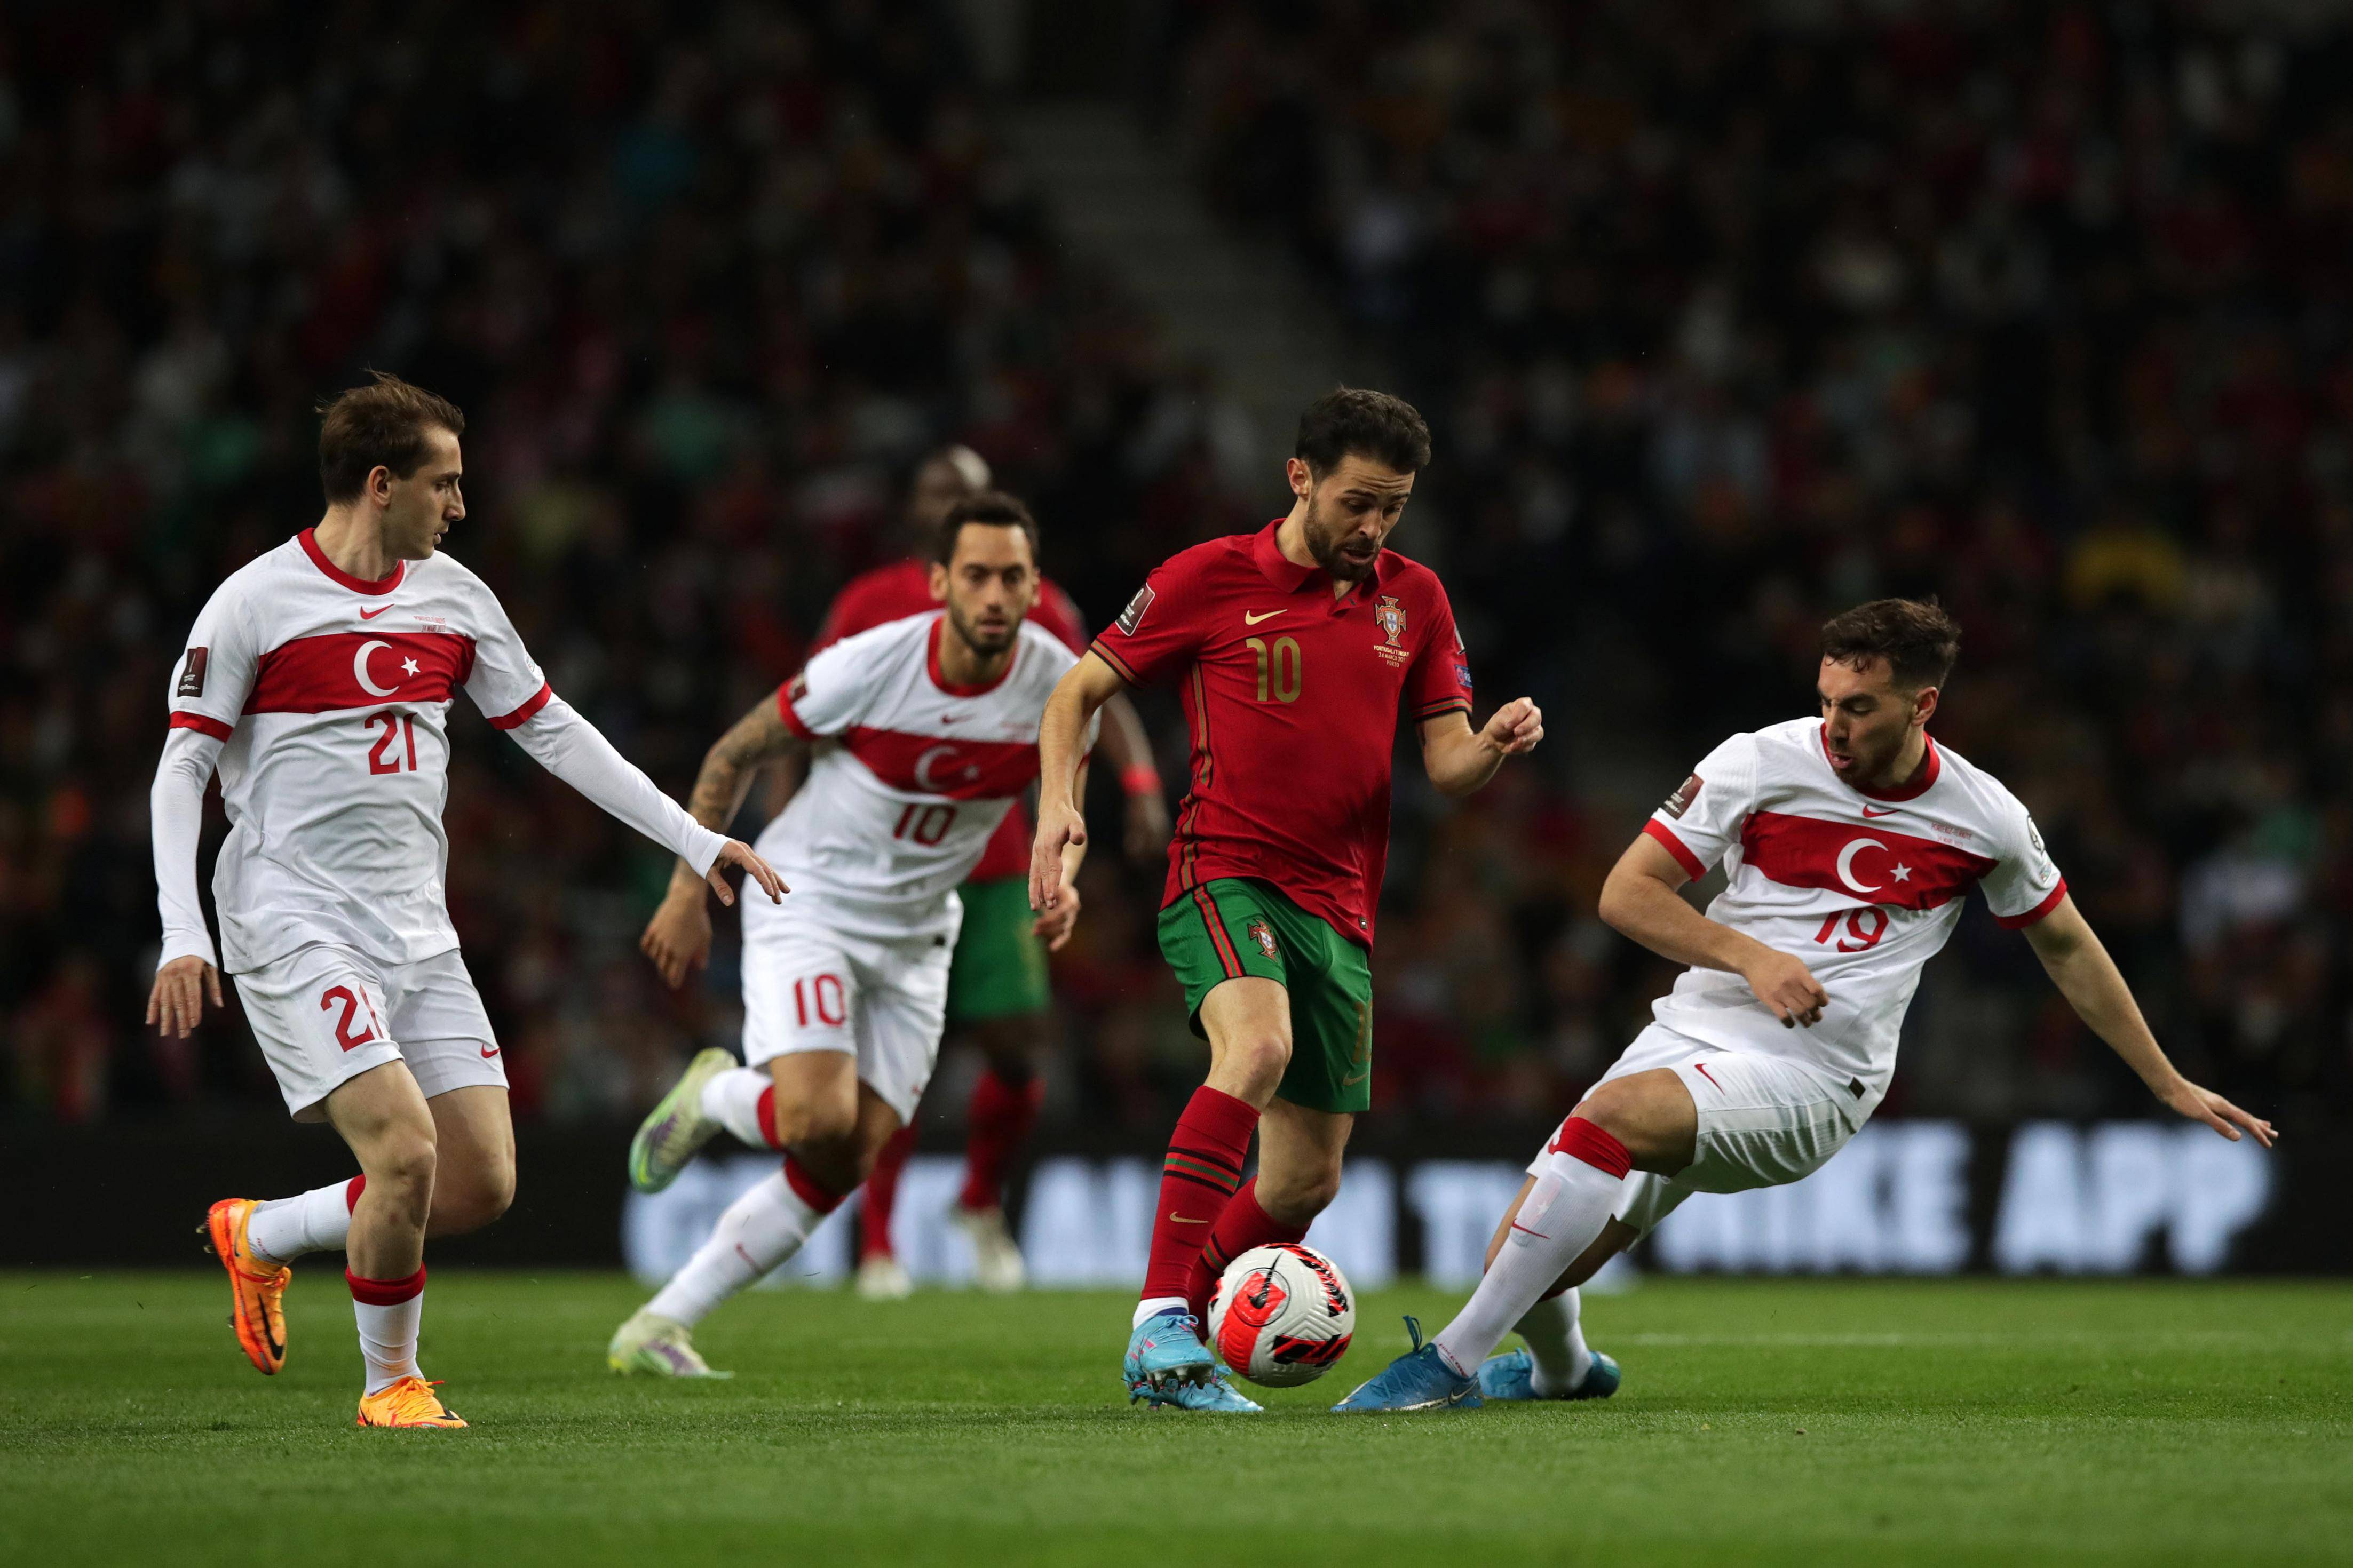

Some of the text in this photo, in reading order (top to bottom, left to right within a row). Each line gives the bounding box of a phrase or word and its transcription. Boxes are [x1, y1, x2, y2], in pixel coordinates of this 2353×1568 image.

[1246, 636, 1301, 703] 10
[365, 710, 417, 775] 21
[893, 803, 957, 846] 10
[1814, 906, 1890, 953] 19
[795, 974, 845, 1025] 10
[1991, 1118, 2276, 1275] APP
